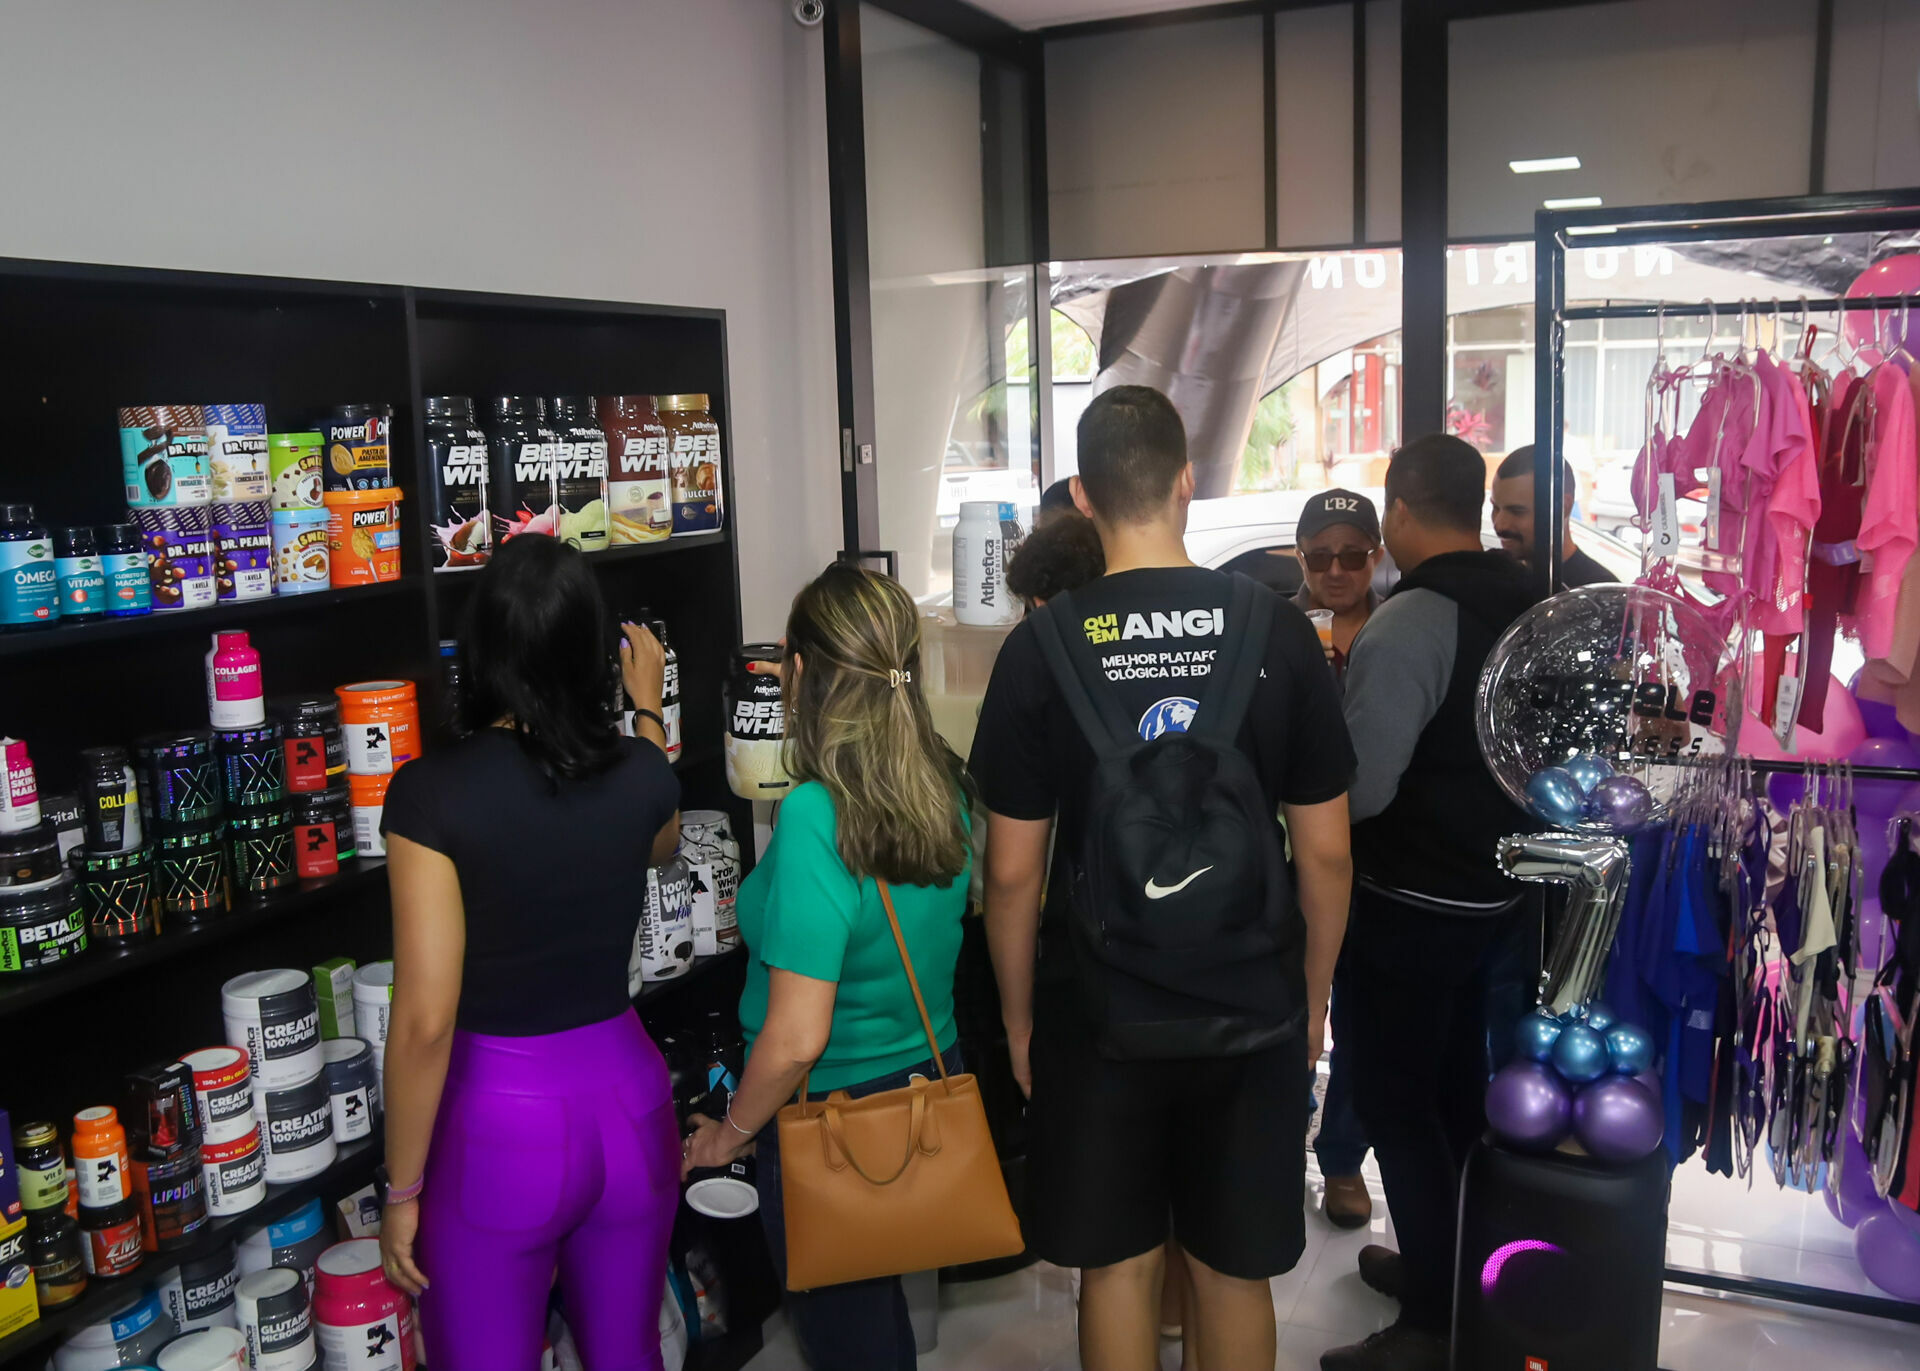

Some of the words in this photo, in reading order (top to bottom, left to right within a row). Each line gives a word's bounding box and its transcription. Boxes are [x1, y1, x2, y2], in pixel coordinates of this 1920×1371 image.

[981, 539, 994, 608] Atlhetica
[1102, 653, 1157, 669] MELHOR
[1105, 664, 1169, 682] OLÓGICA
[1171, 666, 1190, 678] DE
[717, 867, 734, 878] TOP
[650, 885, 660, 936] NUTRITION
